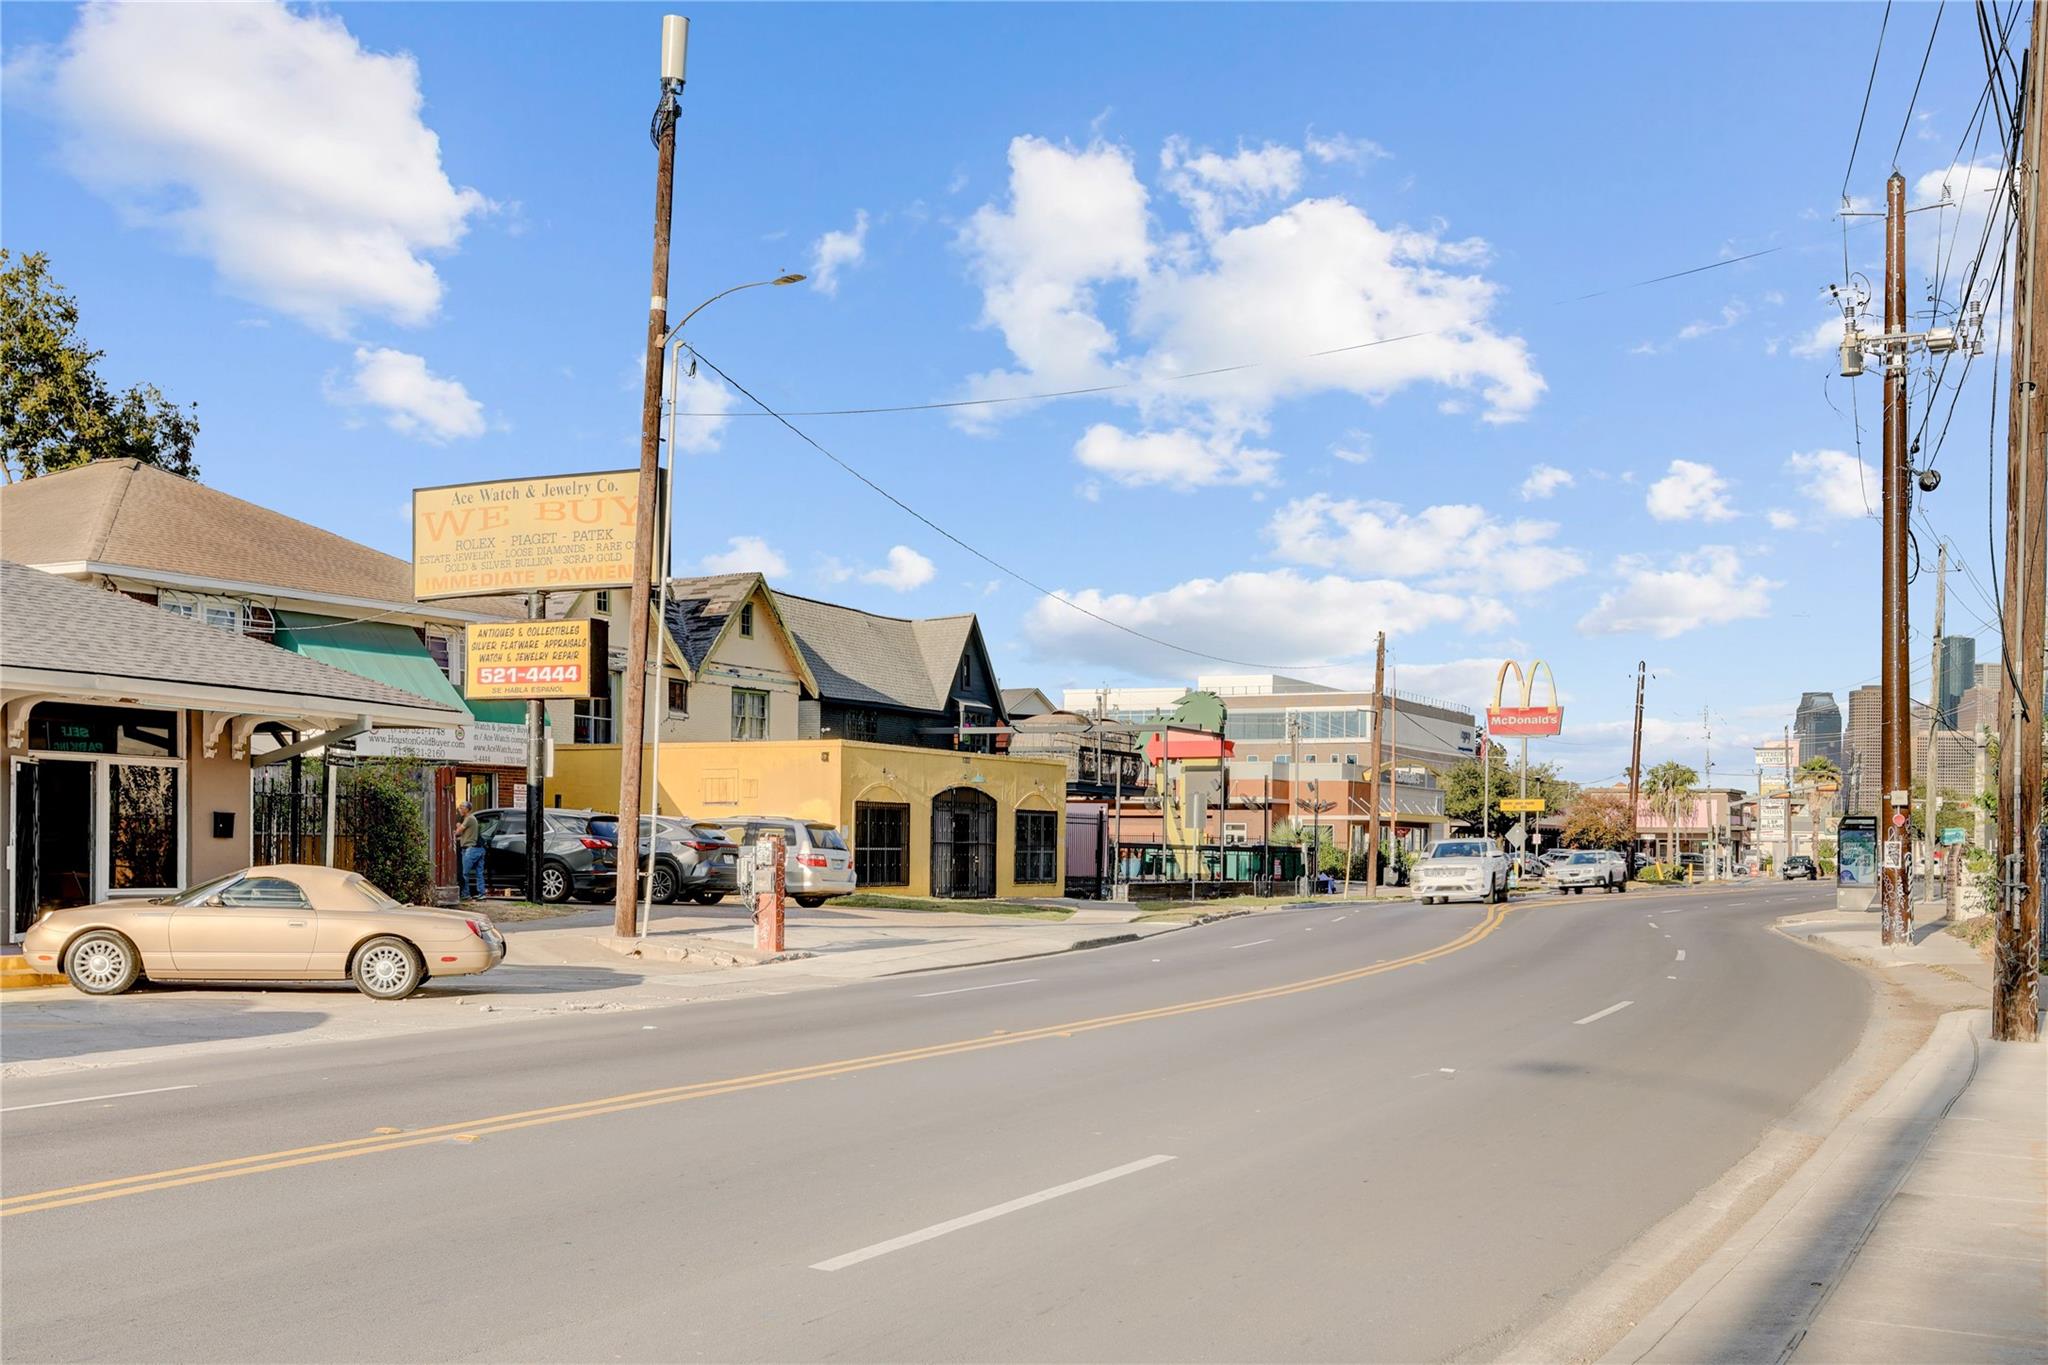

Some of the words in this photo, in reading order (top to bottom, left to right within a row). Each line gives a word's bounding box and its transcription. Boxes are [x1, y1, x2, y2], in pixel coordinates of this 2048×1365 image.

[452, 491, 474, 506] Ace
[480, 486, 520, 501] Watch
[525, 484, 536, 499] &
[542, 481, 591, 497] Jewelry
[597, 478, 618, 493] Co.
[420, 505, 510, 542] WE
[534, 495, 638, 526] BUY
[455, 537, 496, 551] ROLEX
[512, 533, 557, 547] PIAGET
[573, 528, 613, 542] PATEK
[420, 554, 451, 564] ESTATE
[453, 550, 495, 562] JEWELRY
[505, 547, 533, 559] LOOSE
[537, 544, 586, 556] DIAMONDS
[596, 542, 622, 552] RARE
[444, 562, 468, 573] GOLD
[471, 562, 478, 571] &
[481, 559, 511, 570] SILVER
[515, 556, 553, 568] BULLION
[563, 554, 593, 565] SCRAP
[596, 553, 622, 562] GOLD
[424, 571, 535, 591] IMMEDIATE
[547, 564, 633, 583] PAYMEN
[477, 627, 515, 638] ANTIQUES
[526, 625, 580, 637] COLLECTIBLES
[471, 642, 497, 651] SILVER
[500, 640, 539, 650] FLATWARE
[544, 638, 587, 649] APPRAISALS
[479, 653, 502, 663] WATCH
[515, 652, 549, 662] JEWELRY
[552, 651, 579, 660] REPAIR
[480, 665, 578, 683] 521-4444
[1491, 715, 1557, 725] McDonald's
[369, 735, 466, 749] www.HoustonGoldBuyer.com
